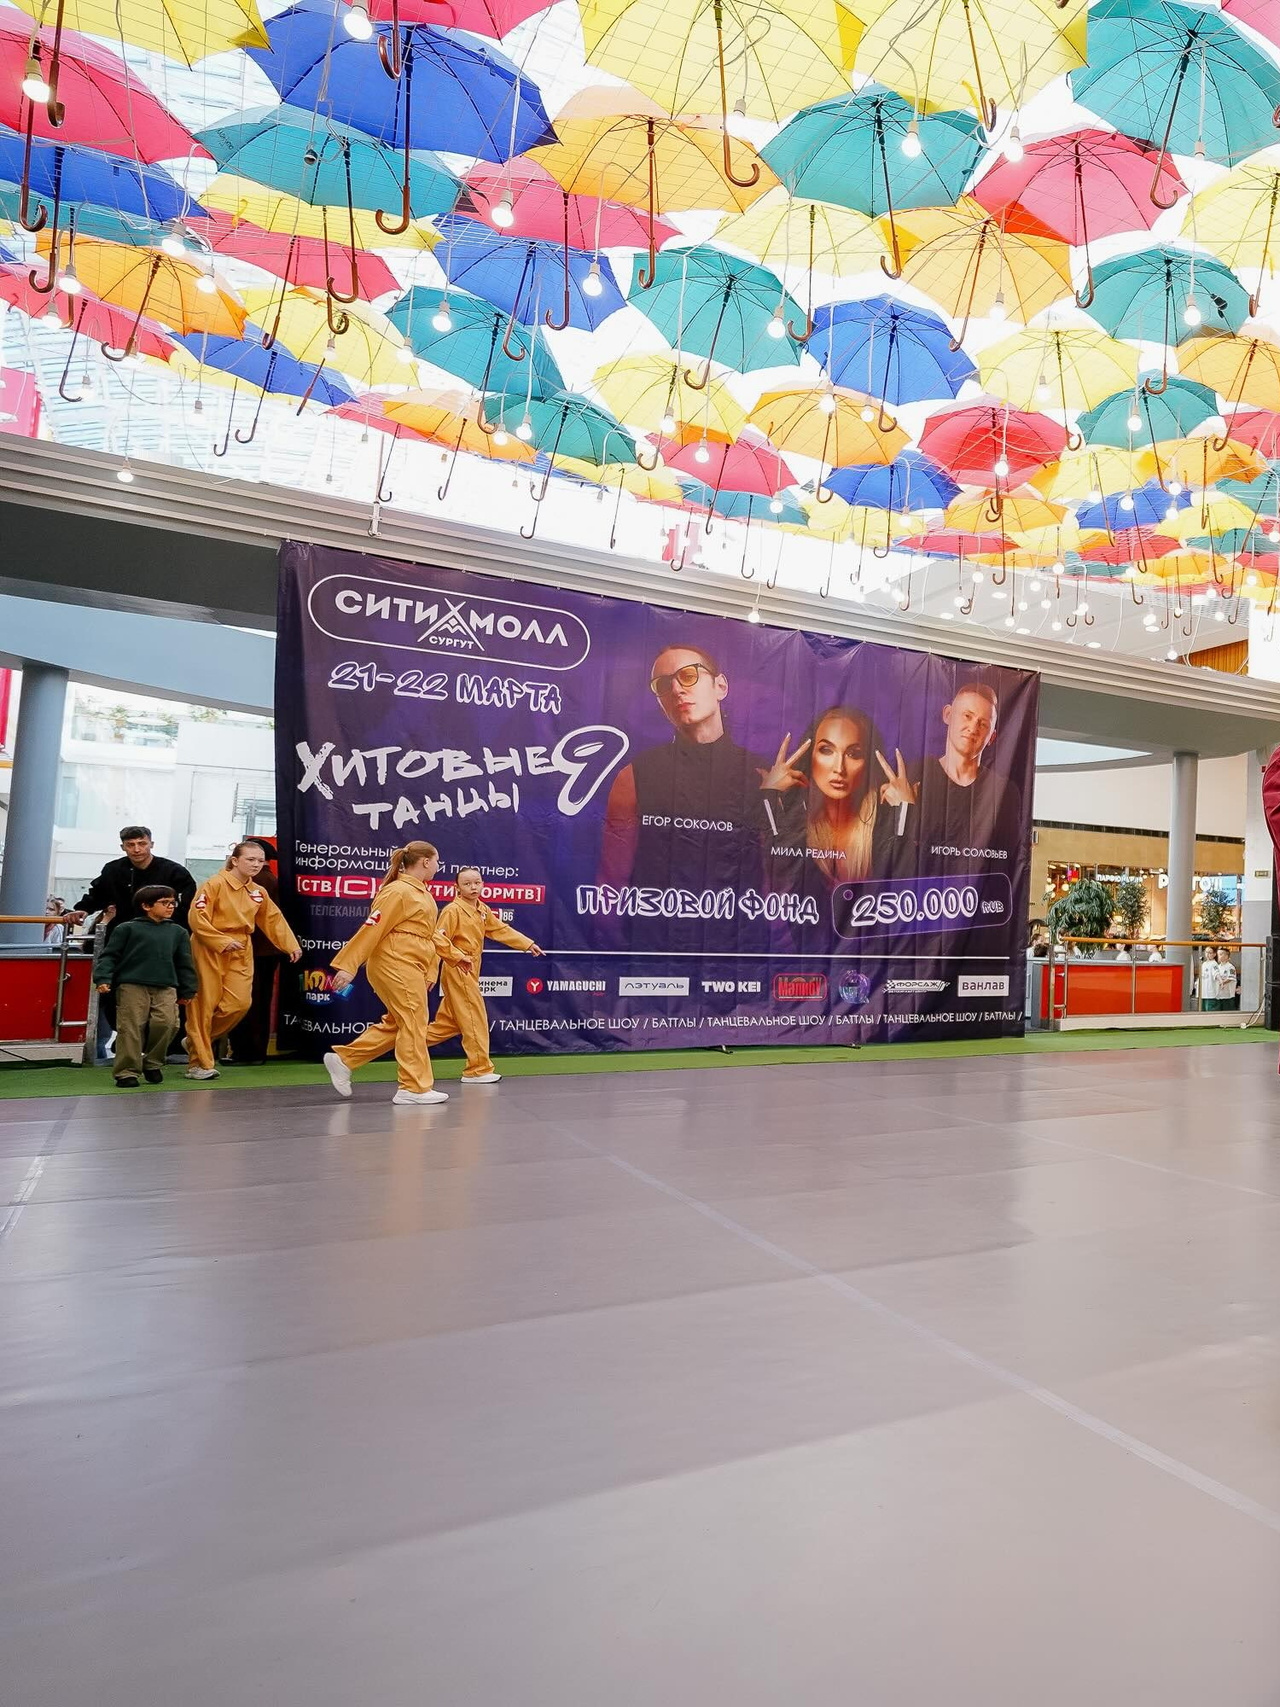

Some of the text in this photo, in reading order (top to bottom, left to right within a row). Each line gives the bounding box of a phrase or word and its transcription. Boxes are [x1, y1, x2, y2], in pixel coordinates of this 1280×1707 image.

[335, 589, 569, 647] СИТИ МОЛЛ
[429, 636, 475, 650] СУРГУТ
[328, 661, 562, 715] 21-22 МАРТА
[353, 782, 521, 831] ТАНЦЫ
[642, 815, 734, 832] ЕГОР СОКОЛОВ
[771, 846, 847, 860] МИЛА РЕДИНА
[931, 845, 1008, 860] ИГОРЬ СОЛОВЬЕВ
[576, 884, 820, 925] ПРИЗОВОЙ ФОНД
[851, 886, 1004, 927] 250.000 RUB
[547, 980, 607, 992] YAMAGUCHI
[701, 981, 761, 993] TWO KEI
[962, 981, 1005, 991] ванлав
[306, 991, 331, 1003] парк
[499, 1018, 605, 1032] ТАНЦЕВАЛЬНОЕ
[608, 1017, 640, 1029] ШОУ
[652, 1017, 696, 1029] БАТТЛЫ
[707, 1016, 796, 1027] ТАНЦЕВАЛЬНОЕ
[799, 1015, 826, 1026] ШОУ
[836, 1014, 874, 1025] БАТТЛЫ
[883, 1012, 954, 1024] ТАНЦЕВАЛЬНОЕ
[956, 1012, 977, 1022] ШОУ
[984, 1011, 1016, 1021] БАТТЛЫ
